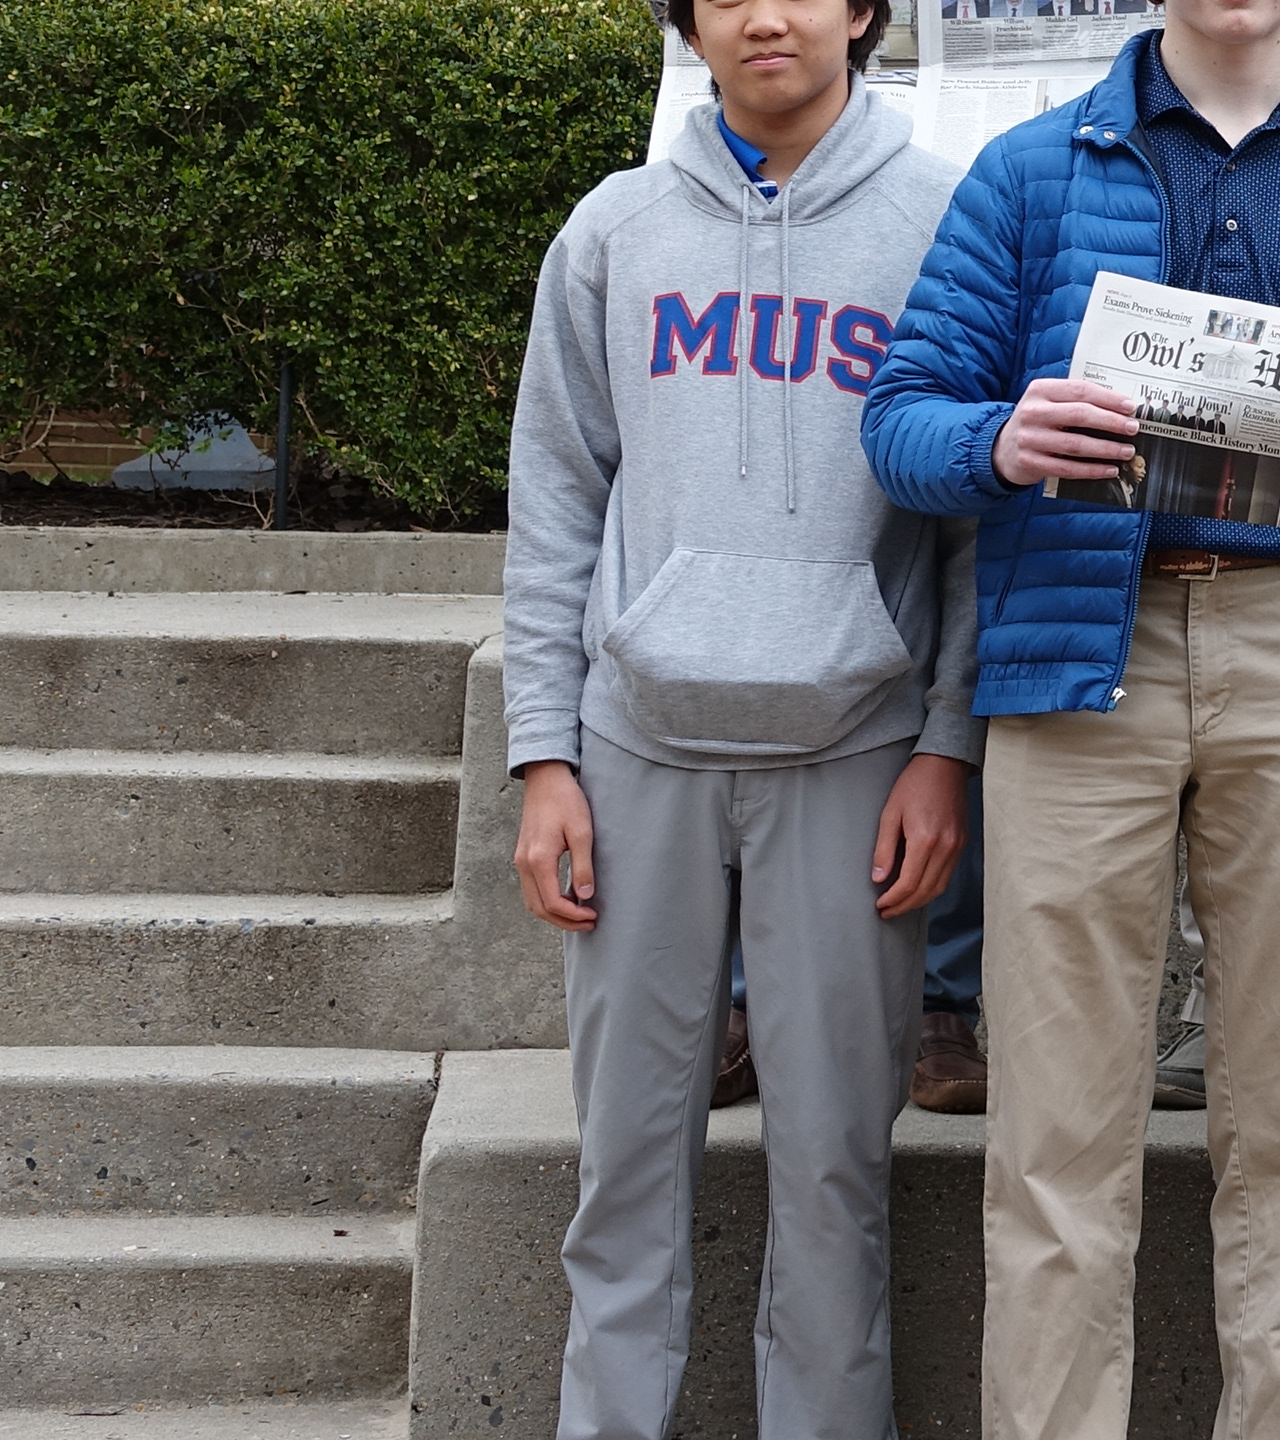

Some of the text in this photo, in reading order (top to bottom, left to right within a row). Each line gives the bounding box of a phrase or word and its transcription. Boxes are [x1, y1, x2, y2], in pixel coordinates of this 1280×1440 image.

[651, 291, 897, 397] MUS
[1124, 331, 1208, 374] Owl's
[1151, 333, 1169, 345] The
[1138, 383, 1233, 415] Write That Down!
[1189, 431, 1218, 444] Black
[1218, 435, 1256, 453] History
